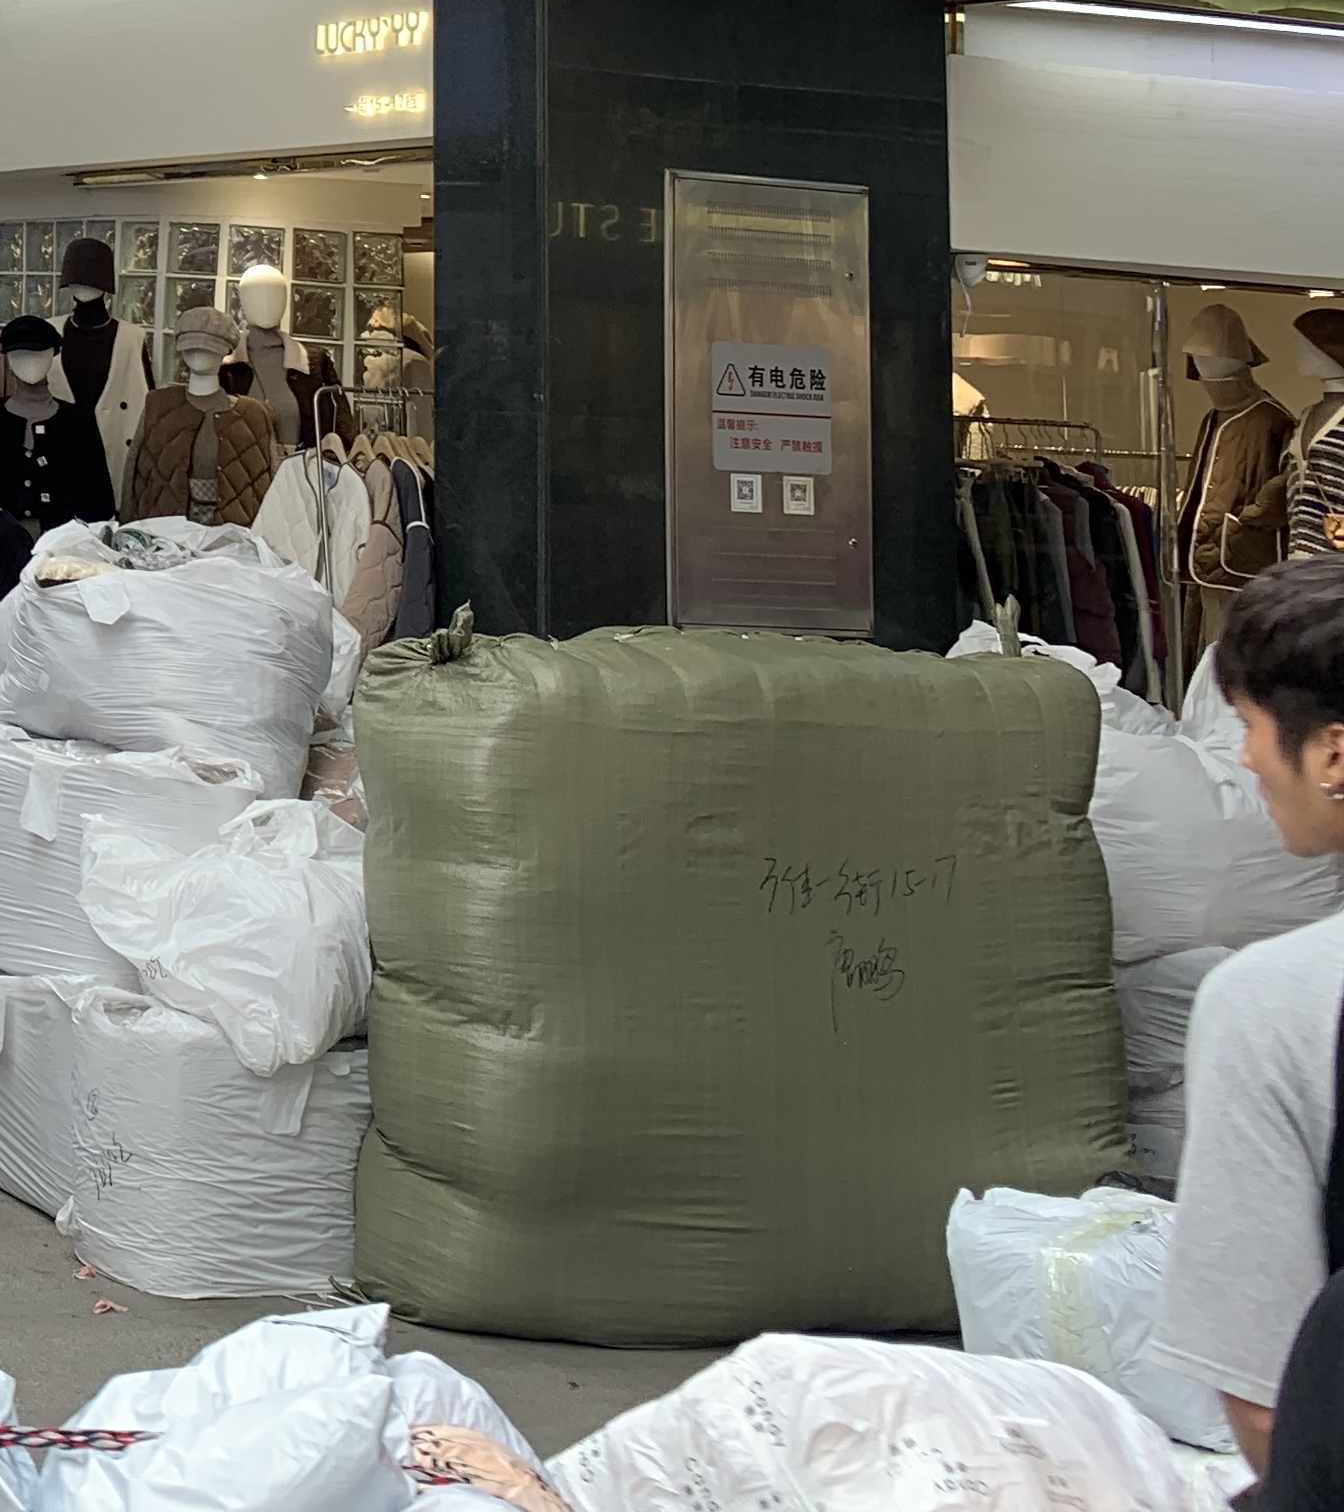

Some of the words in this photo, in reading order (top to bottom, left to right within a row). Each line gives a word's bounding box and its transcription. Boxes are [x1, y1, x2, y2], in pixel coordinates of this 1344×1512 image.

[747, 364, 827, 391] 有电危险
[729, 436, 773, 451] 注意安全
[780, 439, 824, 454] 严禁触摸
